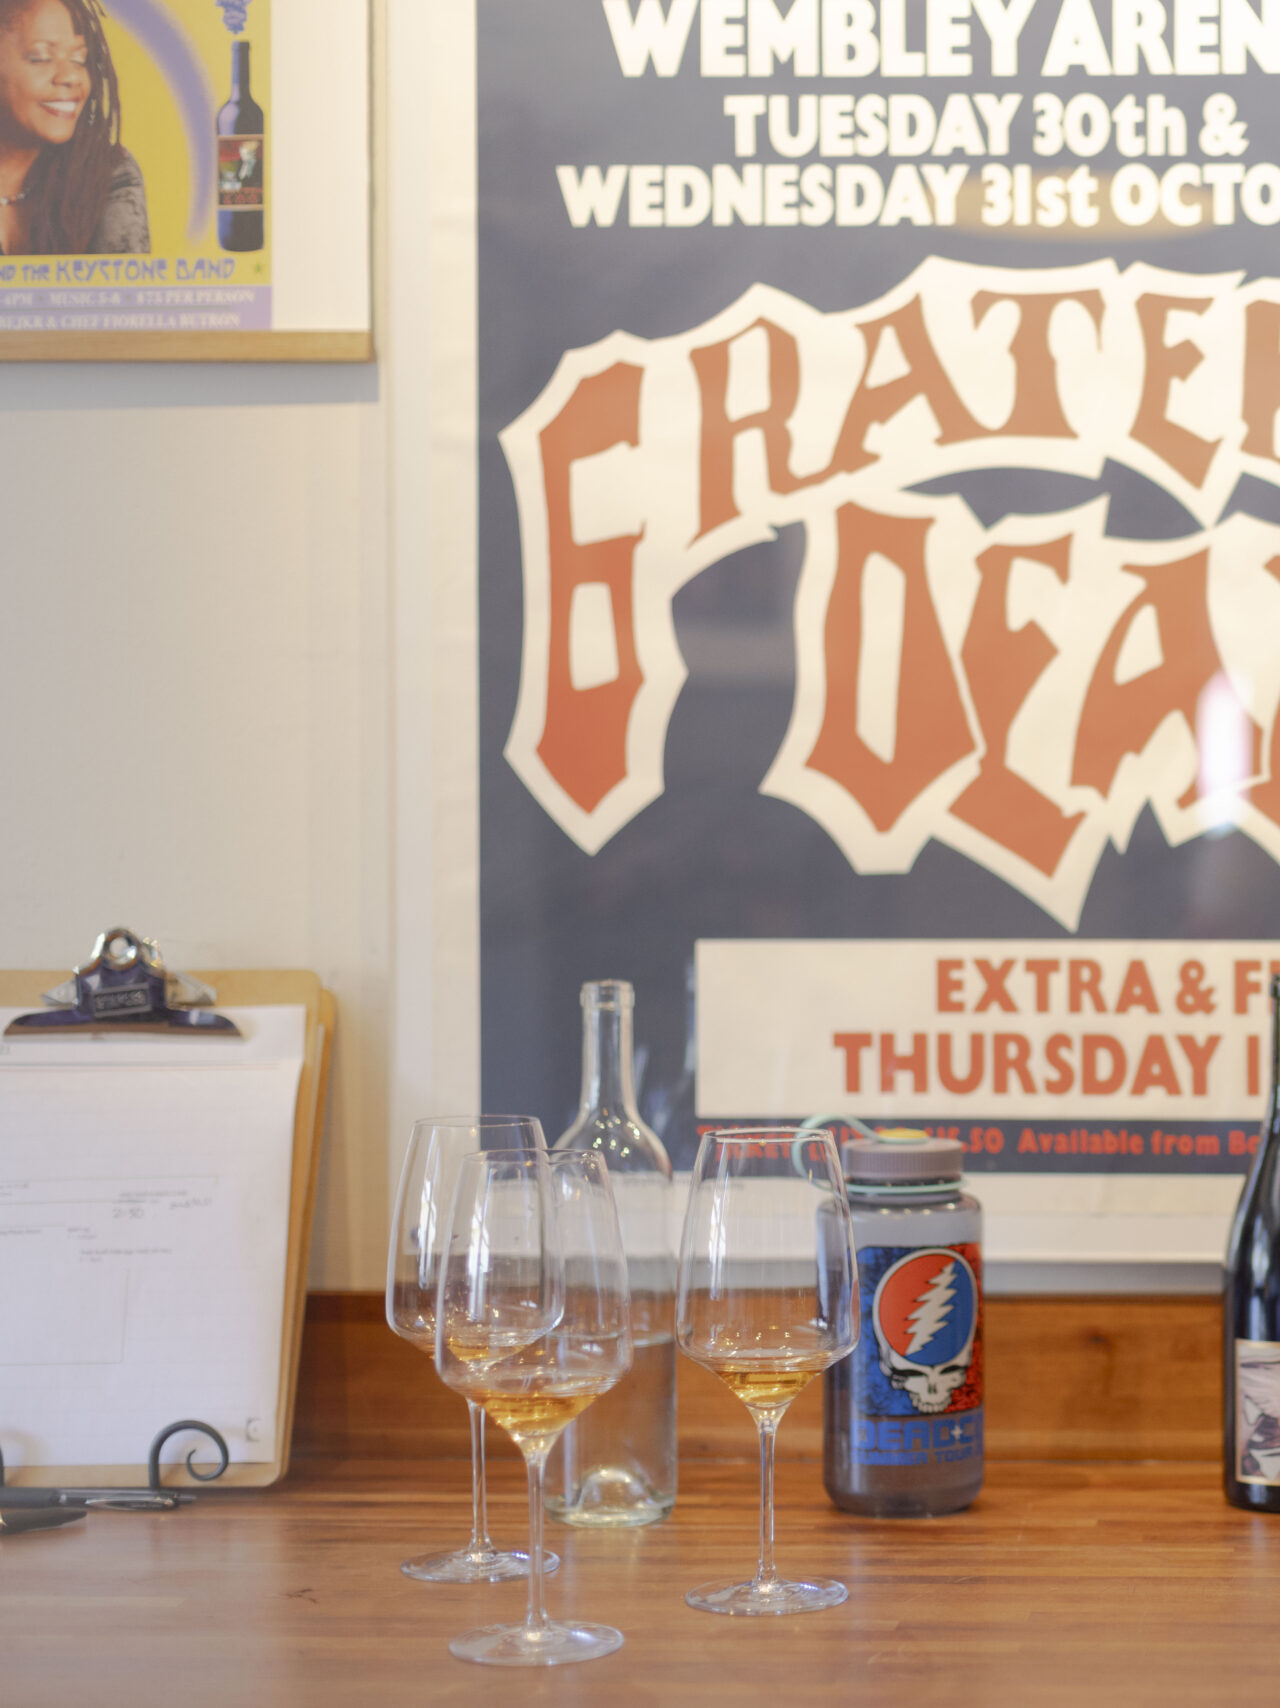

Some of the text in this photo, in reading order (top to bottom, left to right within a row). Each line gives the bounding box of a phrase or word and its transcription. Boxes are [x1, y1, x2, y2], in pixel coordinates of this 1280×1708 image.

[603, 0, 1028, 77] WEMBLEY
[723, 92, 1249, 157] TUESDAY 30th &
[556, 163, 970, 228] WEDNESDAY
[980, 162, 1099, 228] 31st
[176, 257, 236, 281] BAND
[936, 958, 1160, 1014] EXTRA
[1174, 958, 1216, 1015] &
[832, 1031, 1222, 1097] THURSDAY
[1017, 1127, 1144, 1155] Available
[1150, 1129, 1220, 1156] from
